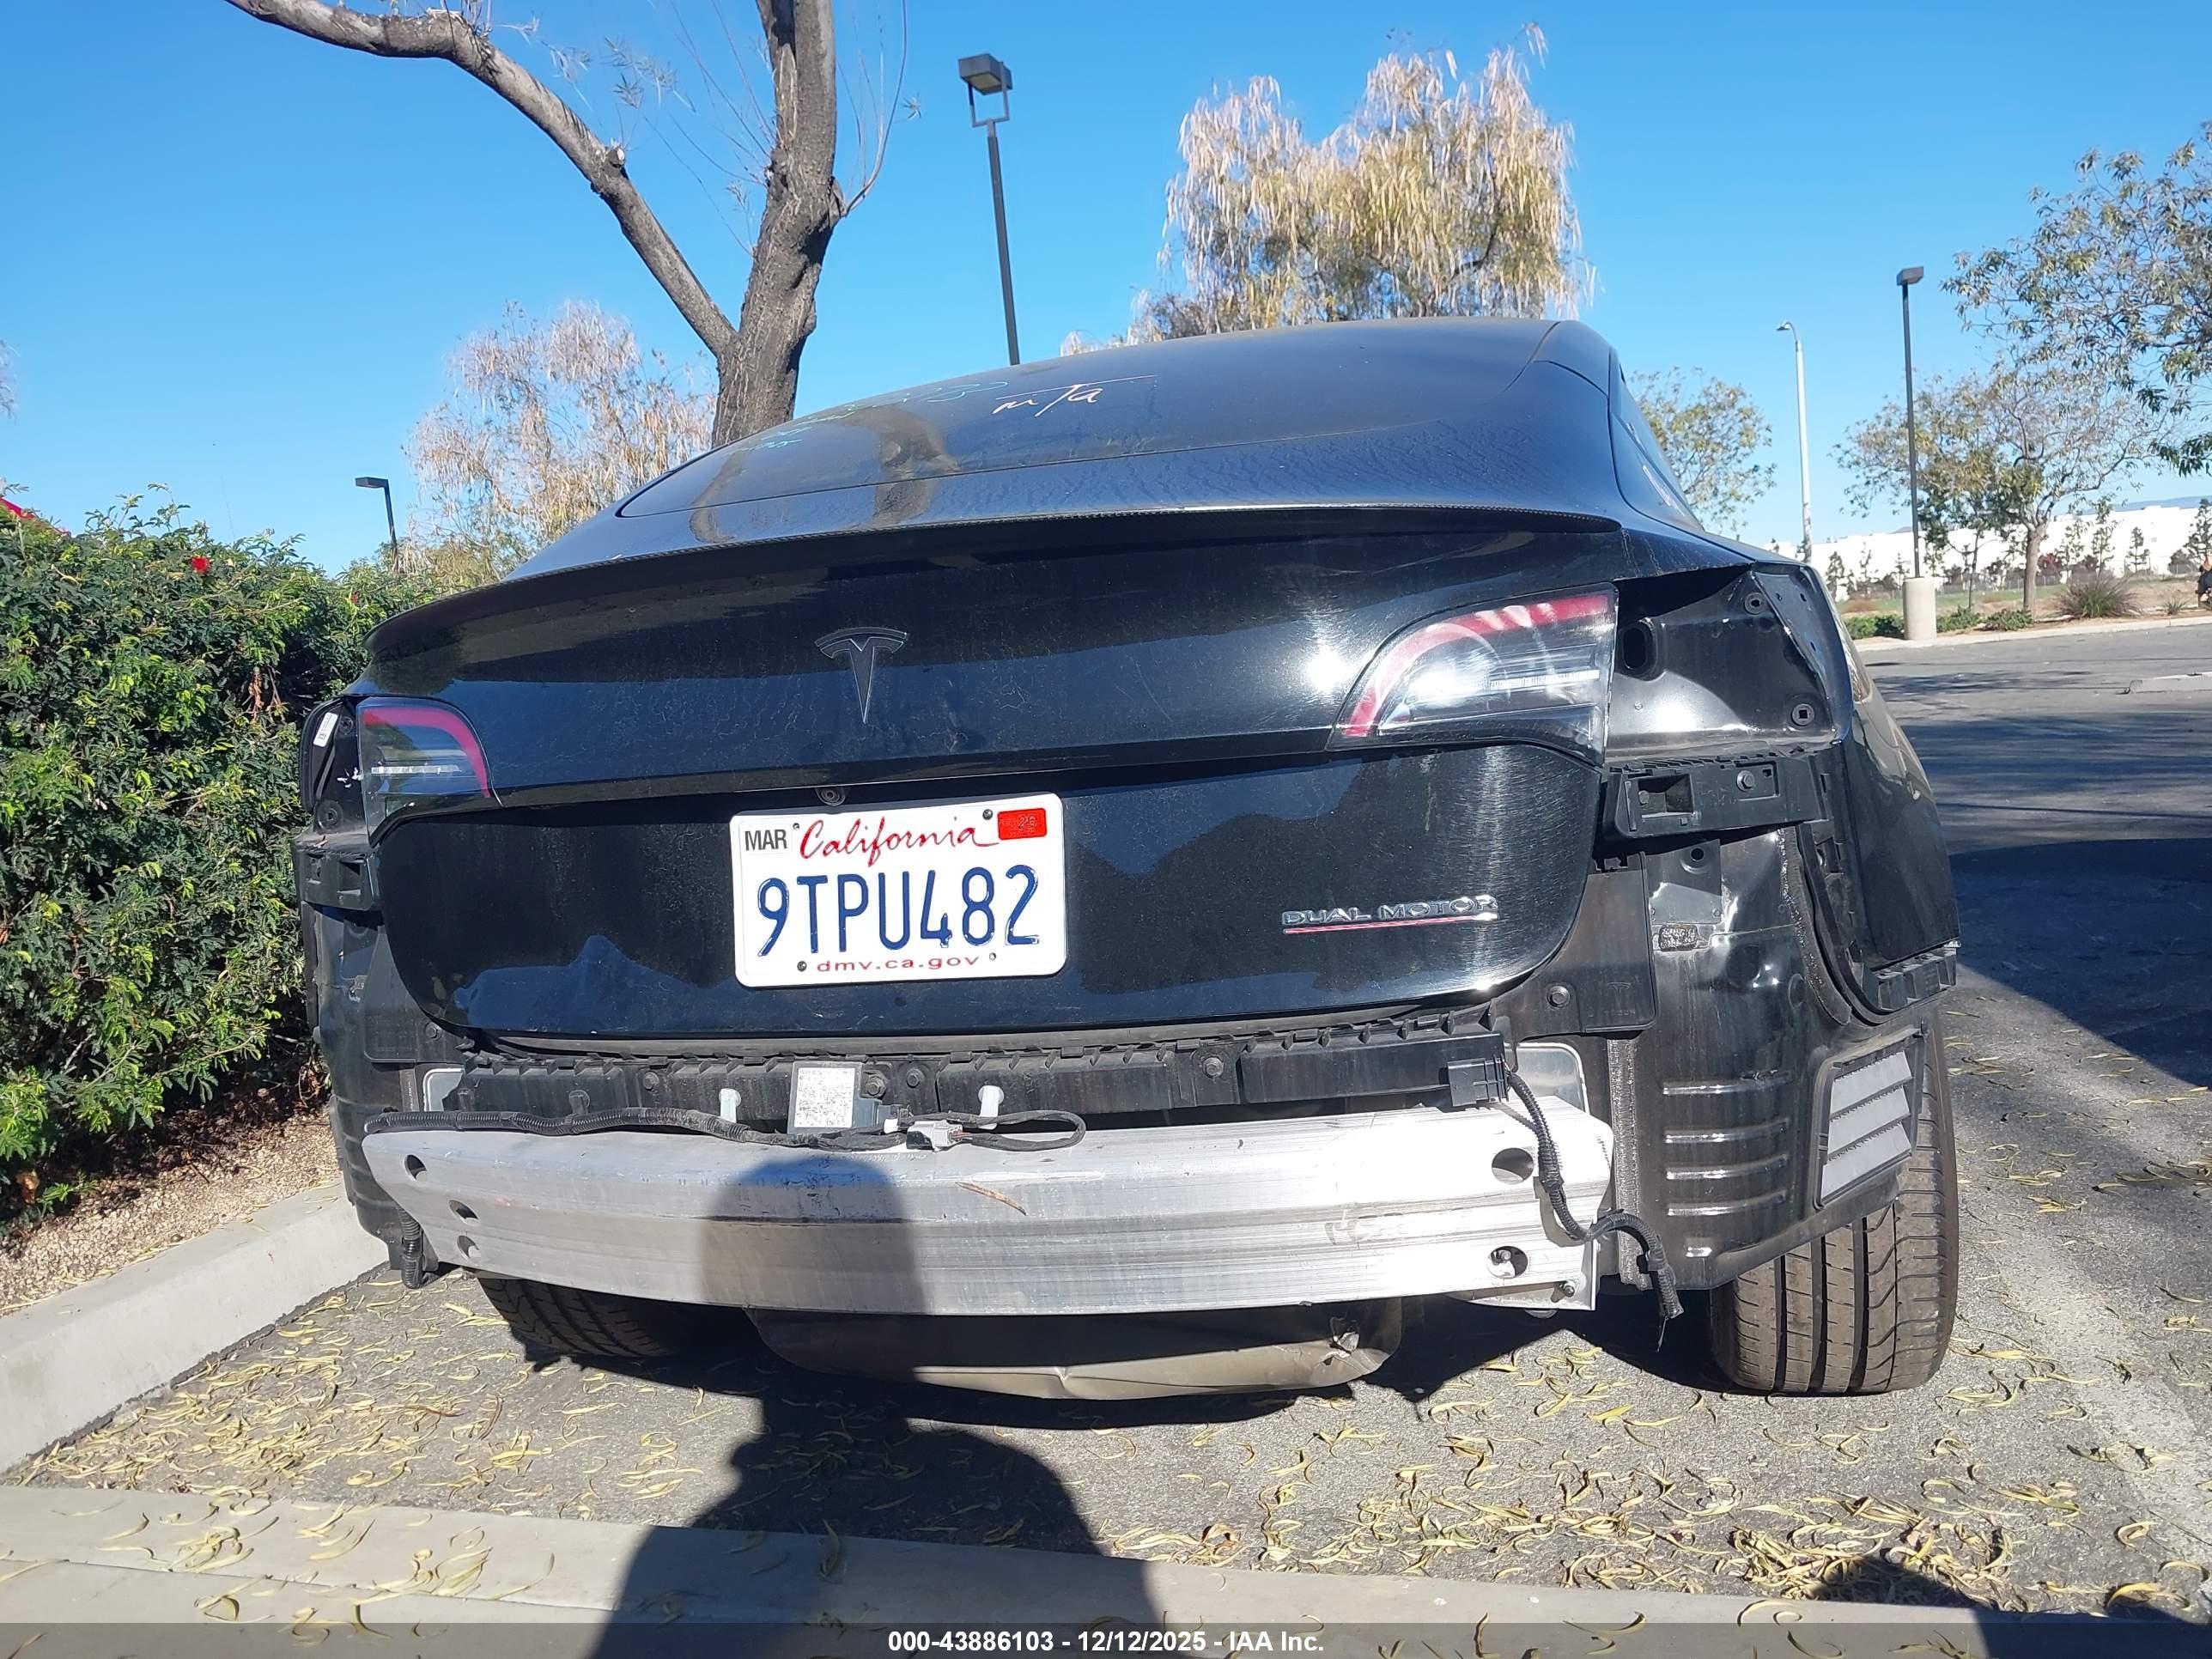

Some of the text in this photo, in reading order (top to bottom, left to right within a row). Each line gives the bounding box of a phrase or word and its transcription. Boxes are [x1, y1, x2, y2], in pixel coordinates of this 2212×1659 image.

[744, 830, 787, 852] MAR
[799, 816, 1000, 866] California
[757, 864, 1040, 957] 9TPU482
[1282, 894, 1498, 926] DUAL MOTOR
[817, 954, 980, 972] dmv.ca.gov
